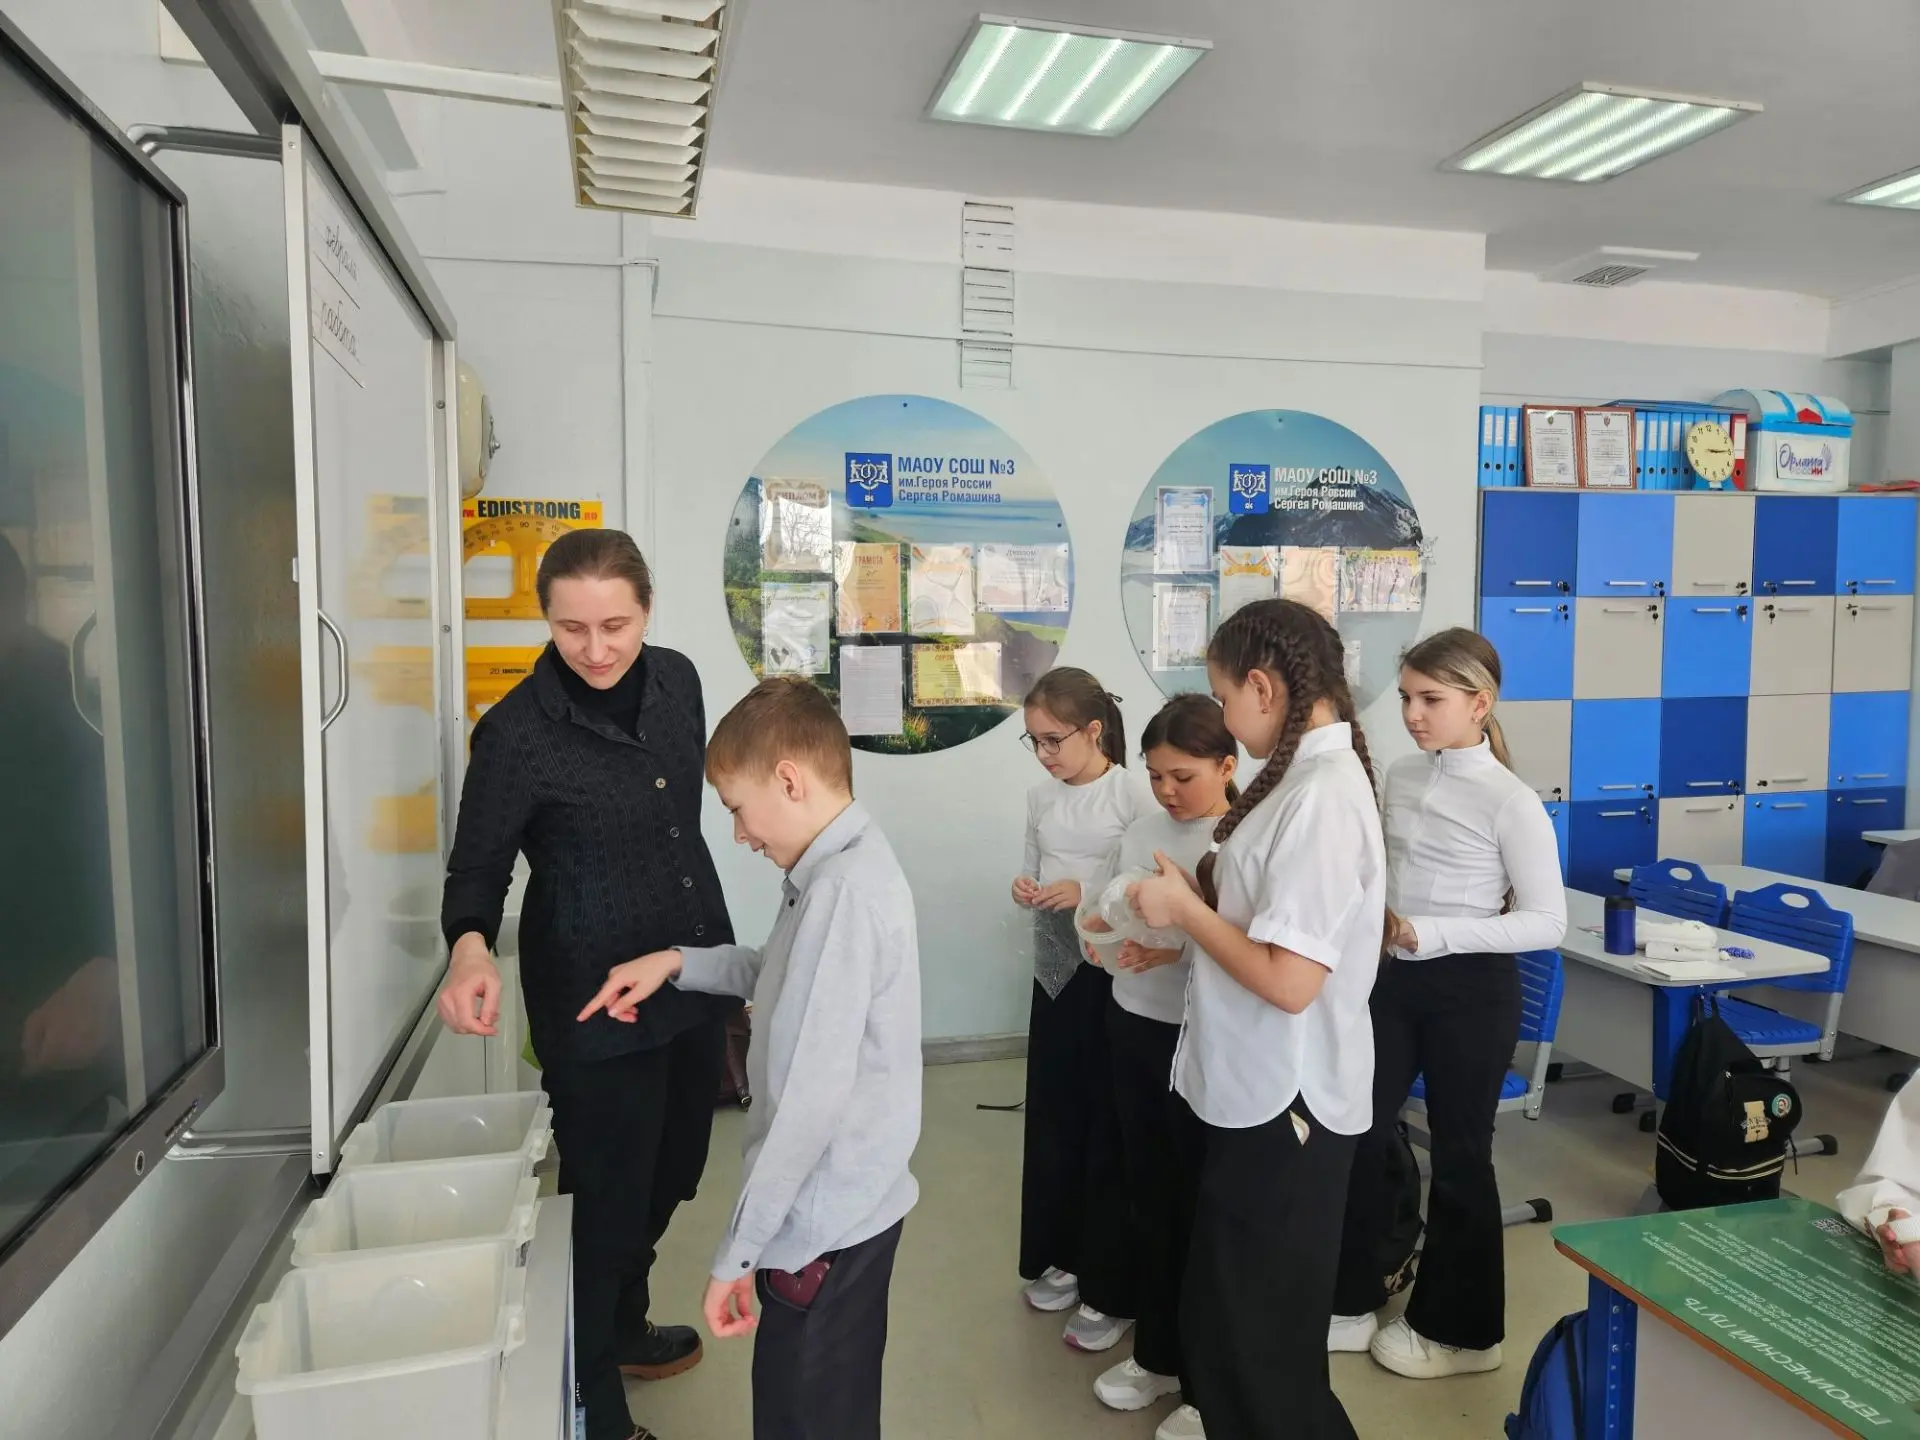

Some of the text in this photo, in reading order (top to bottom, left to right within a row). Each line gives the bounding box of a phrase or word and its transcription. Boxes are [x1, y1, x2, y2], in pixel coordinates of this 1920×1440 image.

[898, 457, 1015, 475] МАОУ СОШ №3
[898, 476, 992, 490] им.Героя России
[1274, 467, 1378, 485] МАОУ СОШ №3
[898, 489, 1001, 503] Сергея Ромашина
[1321, 486, 1356, 498] России
[477, 500, 581, 520] EDUSTRONG
[1274, 498, 1364, 511] Сергея Ромашина
[1684, 1297, 1892, 1425] ГЕРОИЧЕСКИЙ ПУТЬ
